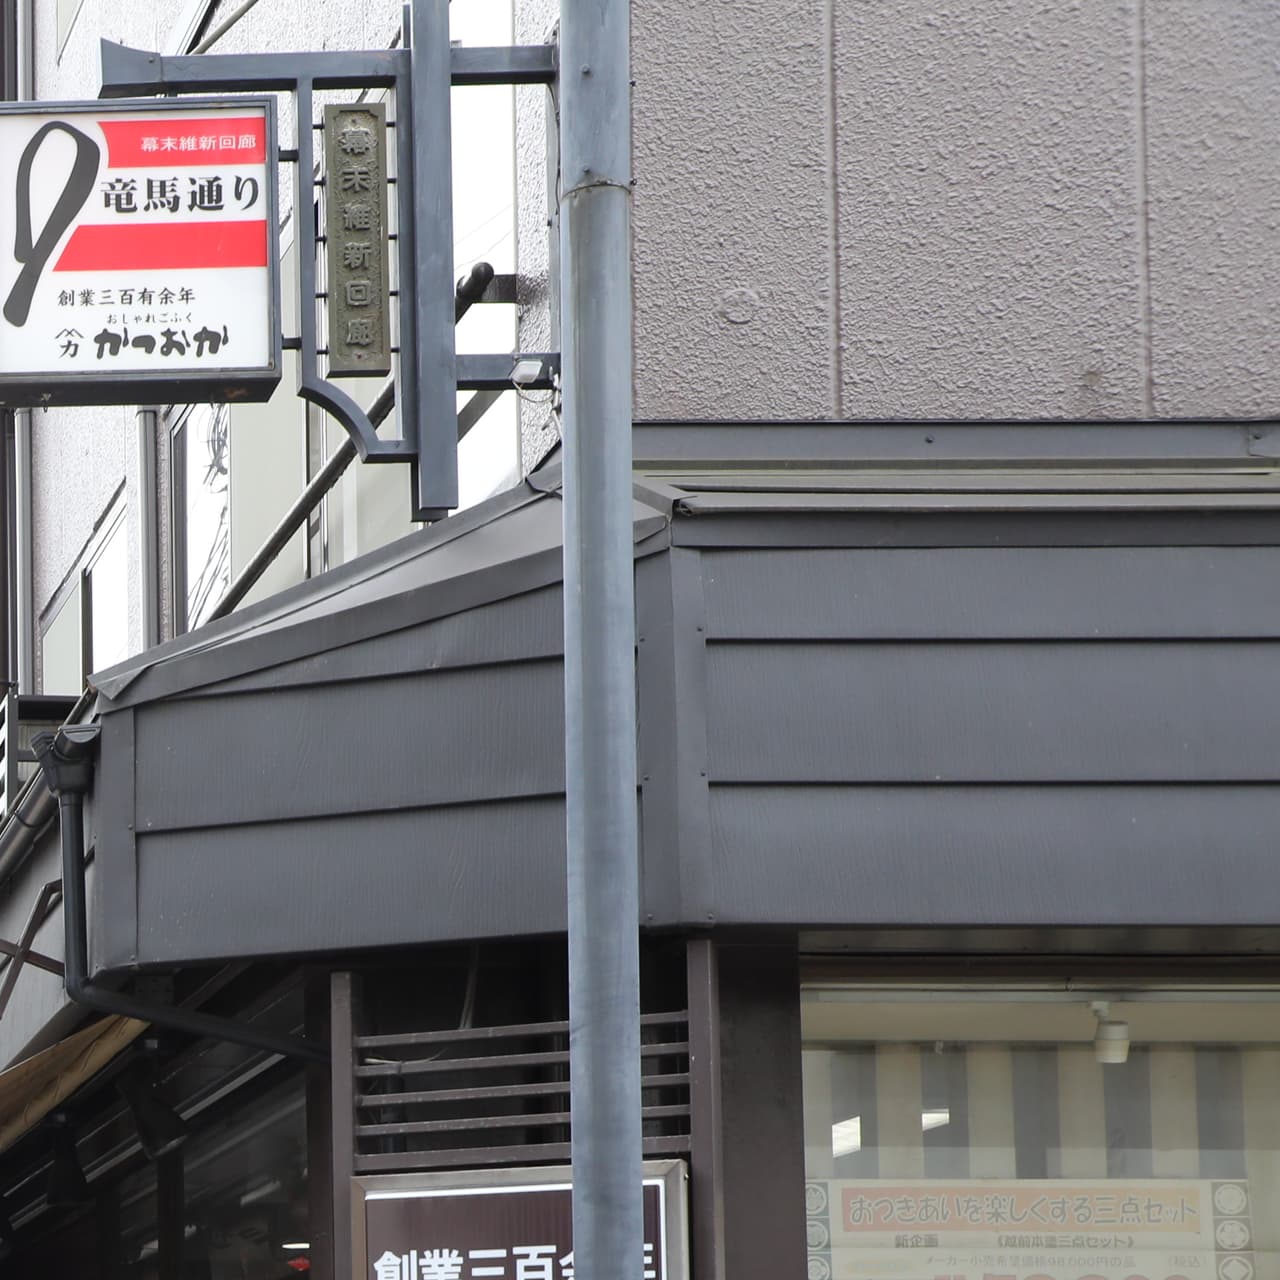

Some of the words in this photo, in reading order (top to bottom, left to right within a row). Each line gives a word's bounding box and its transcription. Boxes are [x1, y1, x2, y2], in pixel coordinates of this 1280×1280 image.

[140, 134, 257, 153] 幕末維新回廊
[100, 175, 260, 214] 竜馬通り
[342, 127, 376, 346] 幕末維新回廊
[57, 286, 196, 308] 創業三百有余年
[106, 312, 193, 324] おしゃれごふく
[94, 327, 229, 360] かつおか
[851, 1195, 1197, 1225] おつきあいを楽しくする三点セット
